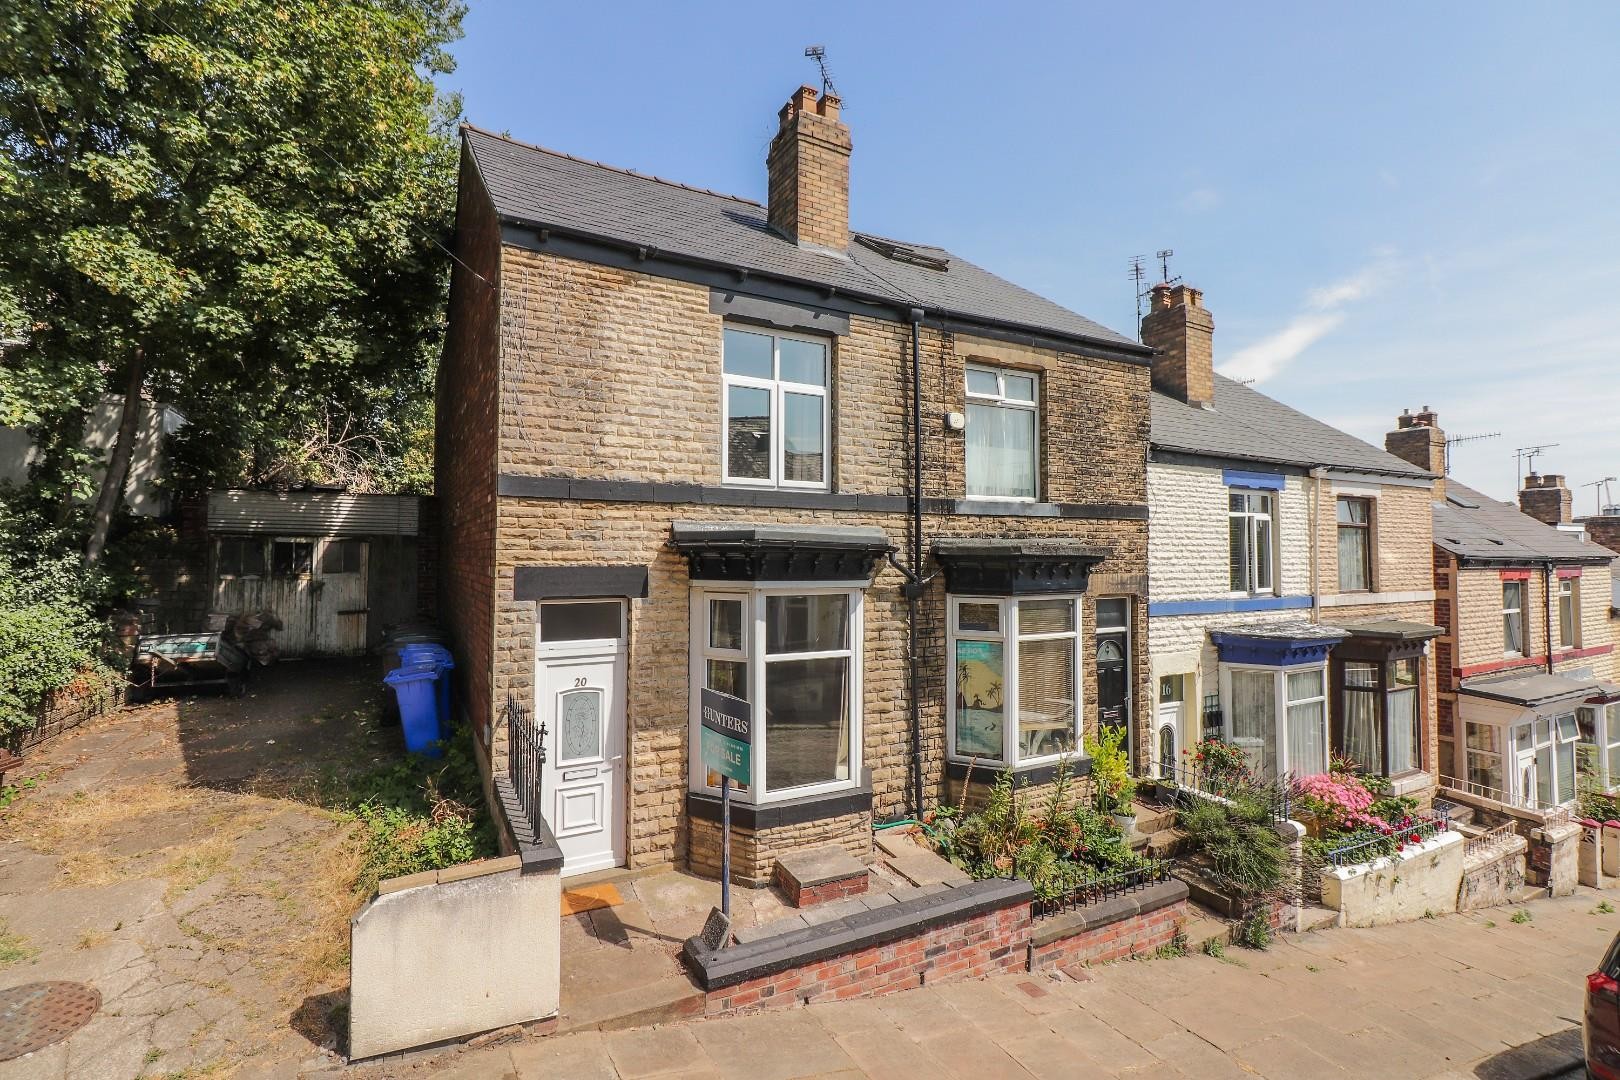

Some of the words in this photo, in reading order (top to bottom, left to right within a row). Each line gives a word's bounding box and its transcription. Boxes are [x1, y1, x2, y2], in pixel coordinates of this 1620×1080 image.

[574, 677, 587, 687] 20
[1162, 683, 1171, 696] 16
[703, 705, 748, 734] HUNTERS
[720, 747, 742, 766] SALE
